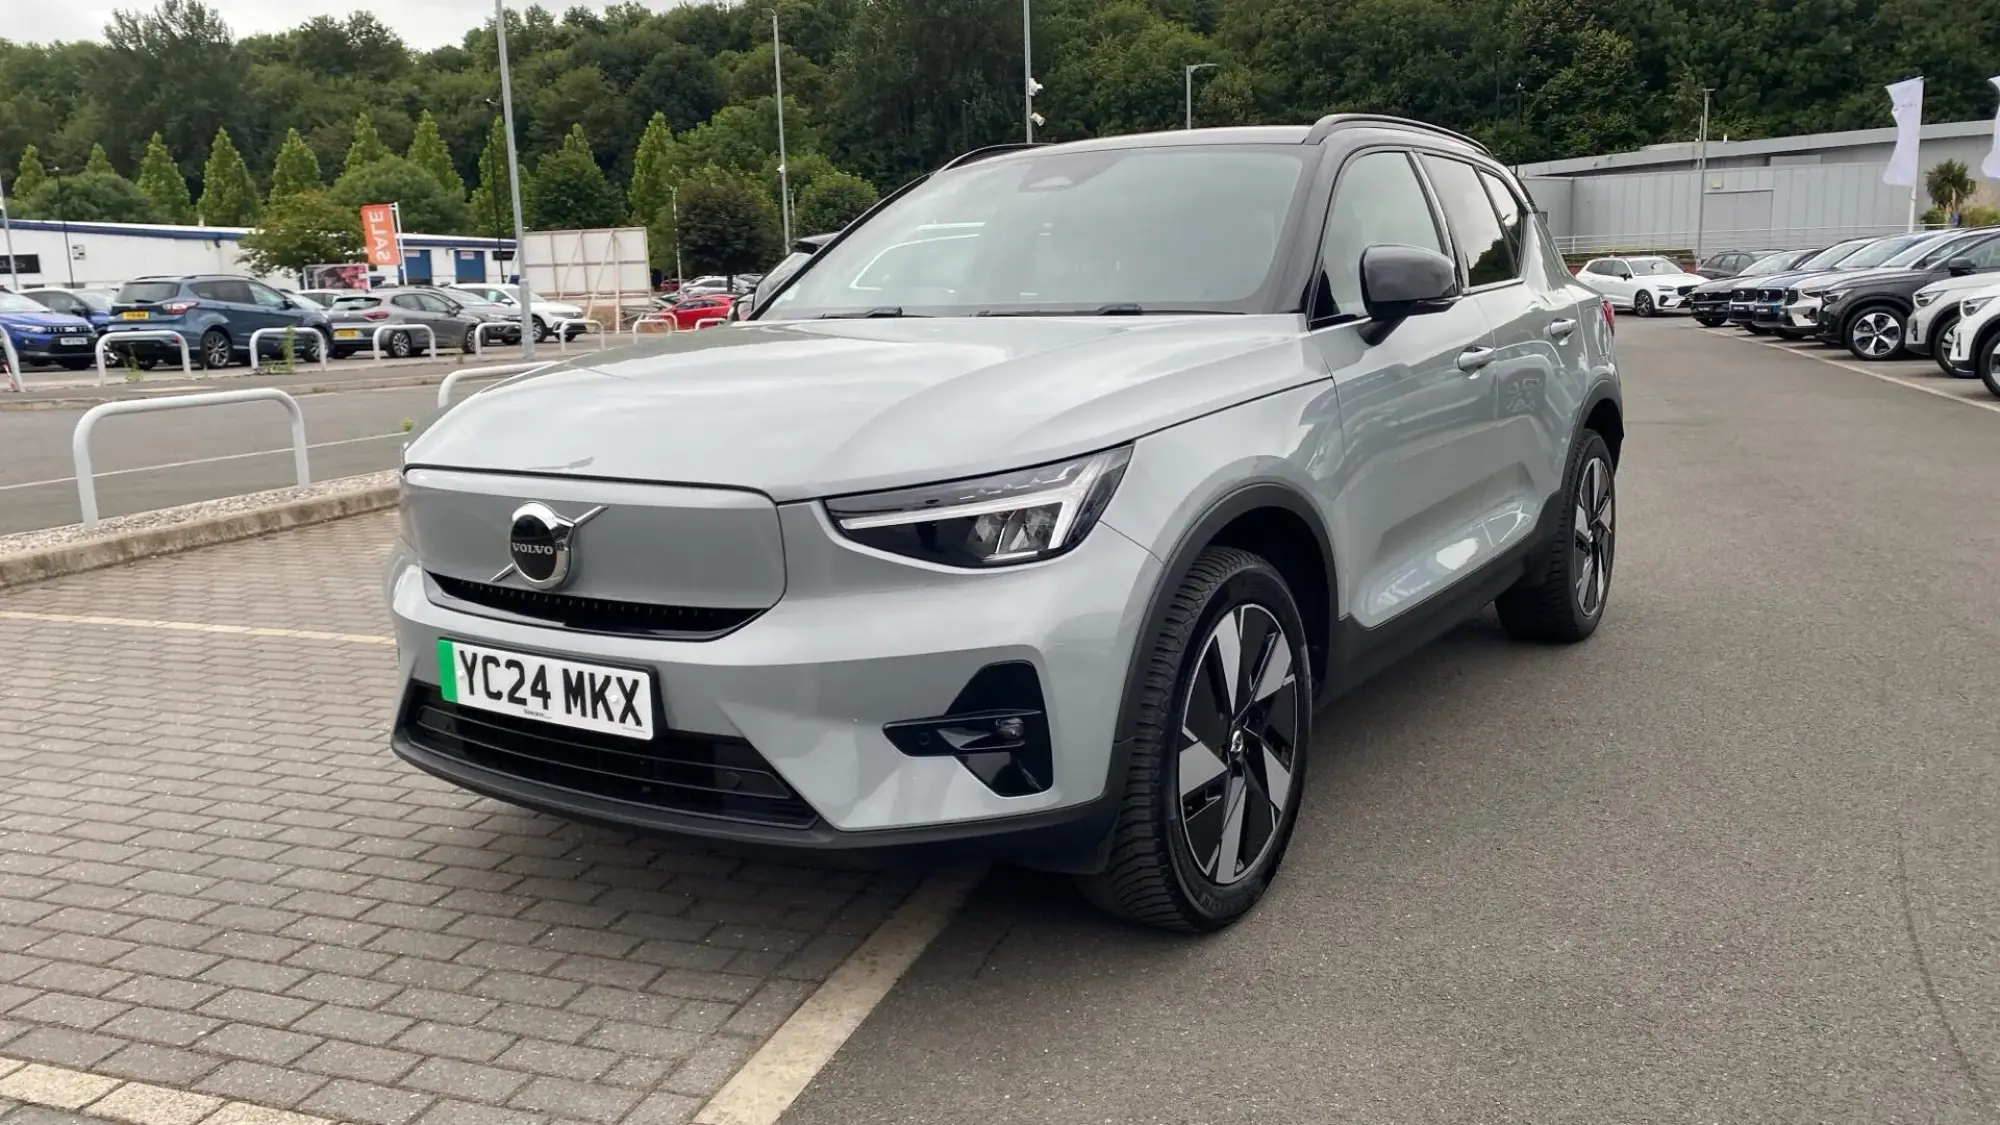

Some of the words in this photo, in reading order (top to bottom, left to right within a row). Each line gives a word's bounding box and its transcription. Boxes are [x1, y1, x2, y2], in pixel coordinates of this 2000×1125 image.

[511, 542, 554, 555] VOLVO
[459, 650, 551, 711] YC24
[562, 668, 643, 727] MKX
